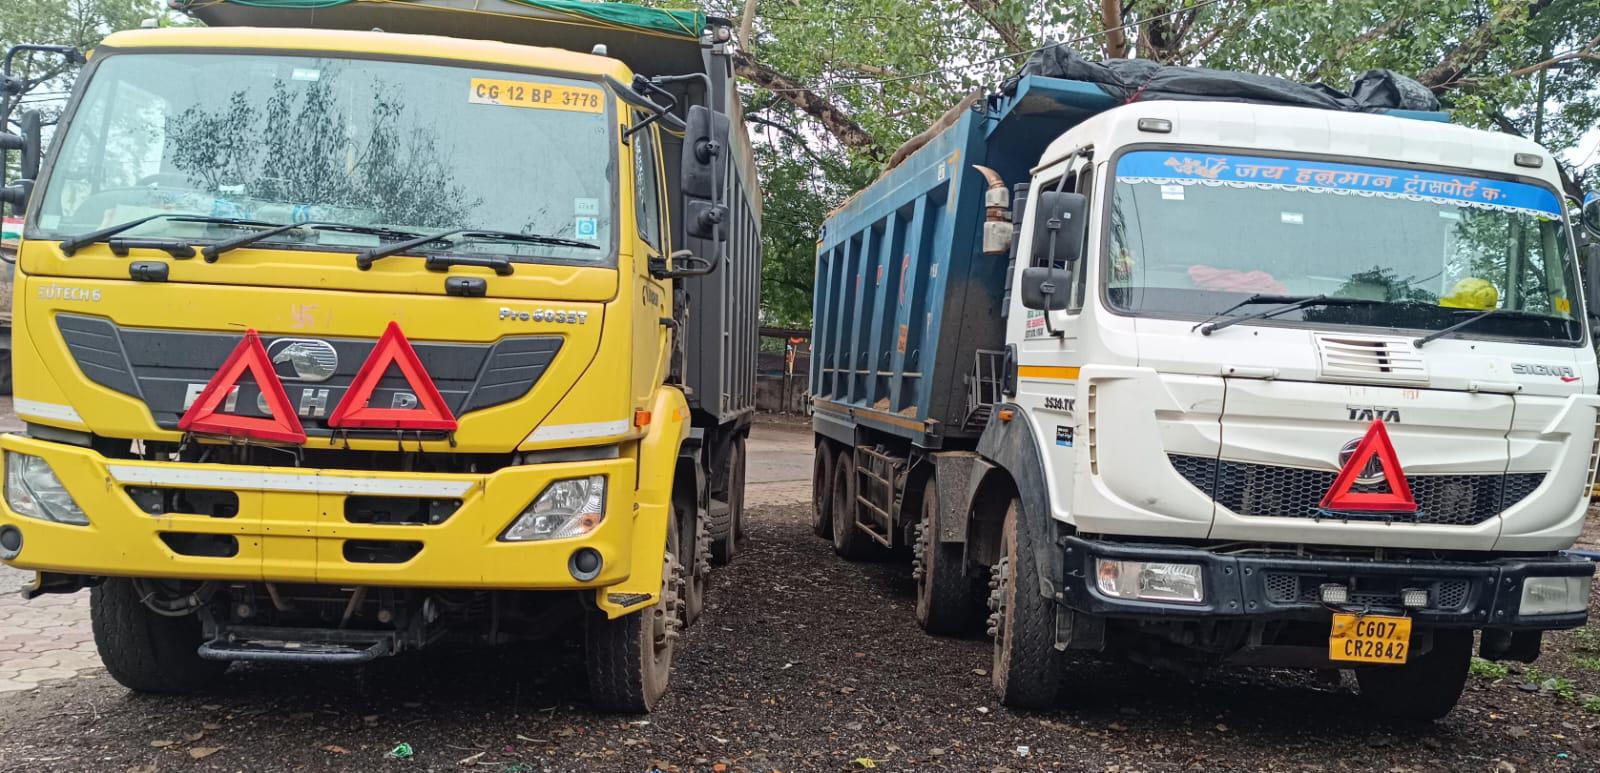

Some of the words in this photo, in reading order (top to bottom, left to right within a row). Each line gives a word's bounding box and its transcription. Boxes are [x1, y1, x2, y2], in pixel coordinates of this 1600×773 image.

[476, 83, 499, 99] CG
[507, 86, 524, 101] 12
[531, 88, 553, 103] BP
[562, 91, 598, 108] 3778
[1235, 163, 1290, 180] जय
[499, 307, 530, 321] Pro
[1511, 362, 1575, 378] SIGNA
[1346, 405, 1400, 423] TATA
[1356, 620, 1397, 639] CG07
[1344, 639, 1405, 660] CR2842
